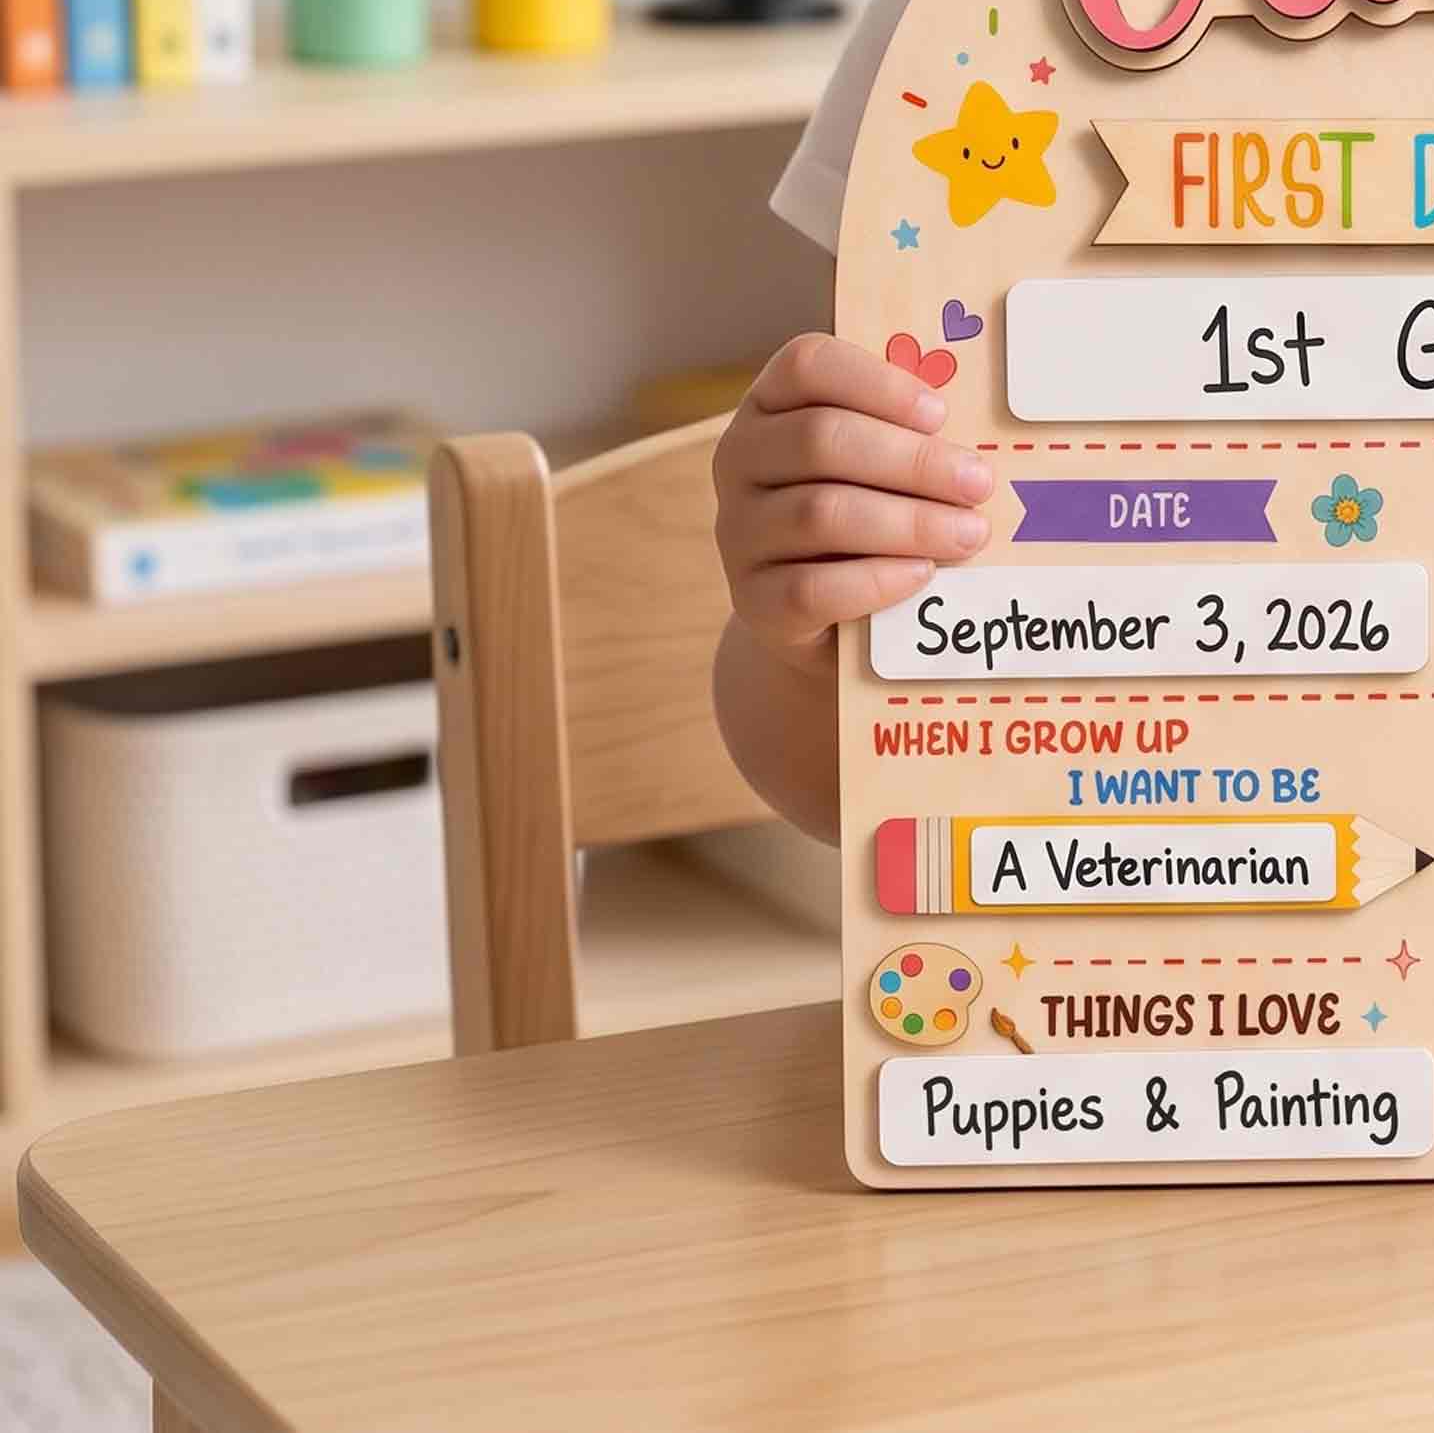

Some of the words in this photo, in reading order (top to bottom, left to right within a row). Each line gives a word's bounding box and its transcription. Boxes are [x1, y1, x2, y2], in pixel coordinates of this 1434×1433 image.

[1172, 131, 1375, 230] FIRST
[1202, 304, 1326, 392] 1st
[1108, 492, 1192, 528] DATE
[916, 596, 1170, 670] September
[1195, 594, 1245, 663] 3,
[1266, 598, 1390, 652] 2026
[873, 721, 969, 756] WHEN
[979, 722, 992, 754] I
[1004, 720, 1124, 754] GROW
[1136, 718, 1190, 754] UP
[1068, 770, 1083, 806] I
[1095, 770, 1200, 804] WANT
[1212, 769, 1260, 803] TO
[1272, 768, 1321, 803] BE
[992, 840, 1027, 892] A
[1046, 838, 1310, 890] Veterinarian
[1040, 994, 1196, 1038] THINGS
[1208, 994, 1224, 1036] I
[1238, 992, 1341, 1036] LOVE
[922, 1075, 1103, 1150] Puppies
[1145, 1076, 1180, 1132] &
[1214, 1070, 1399, 1146] Painting
